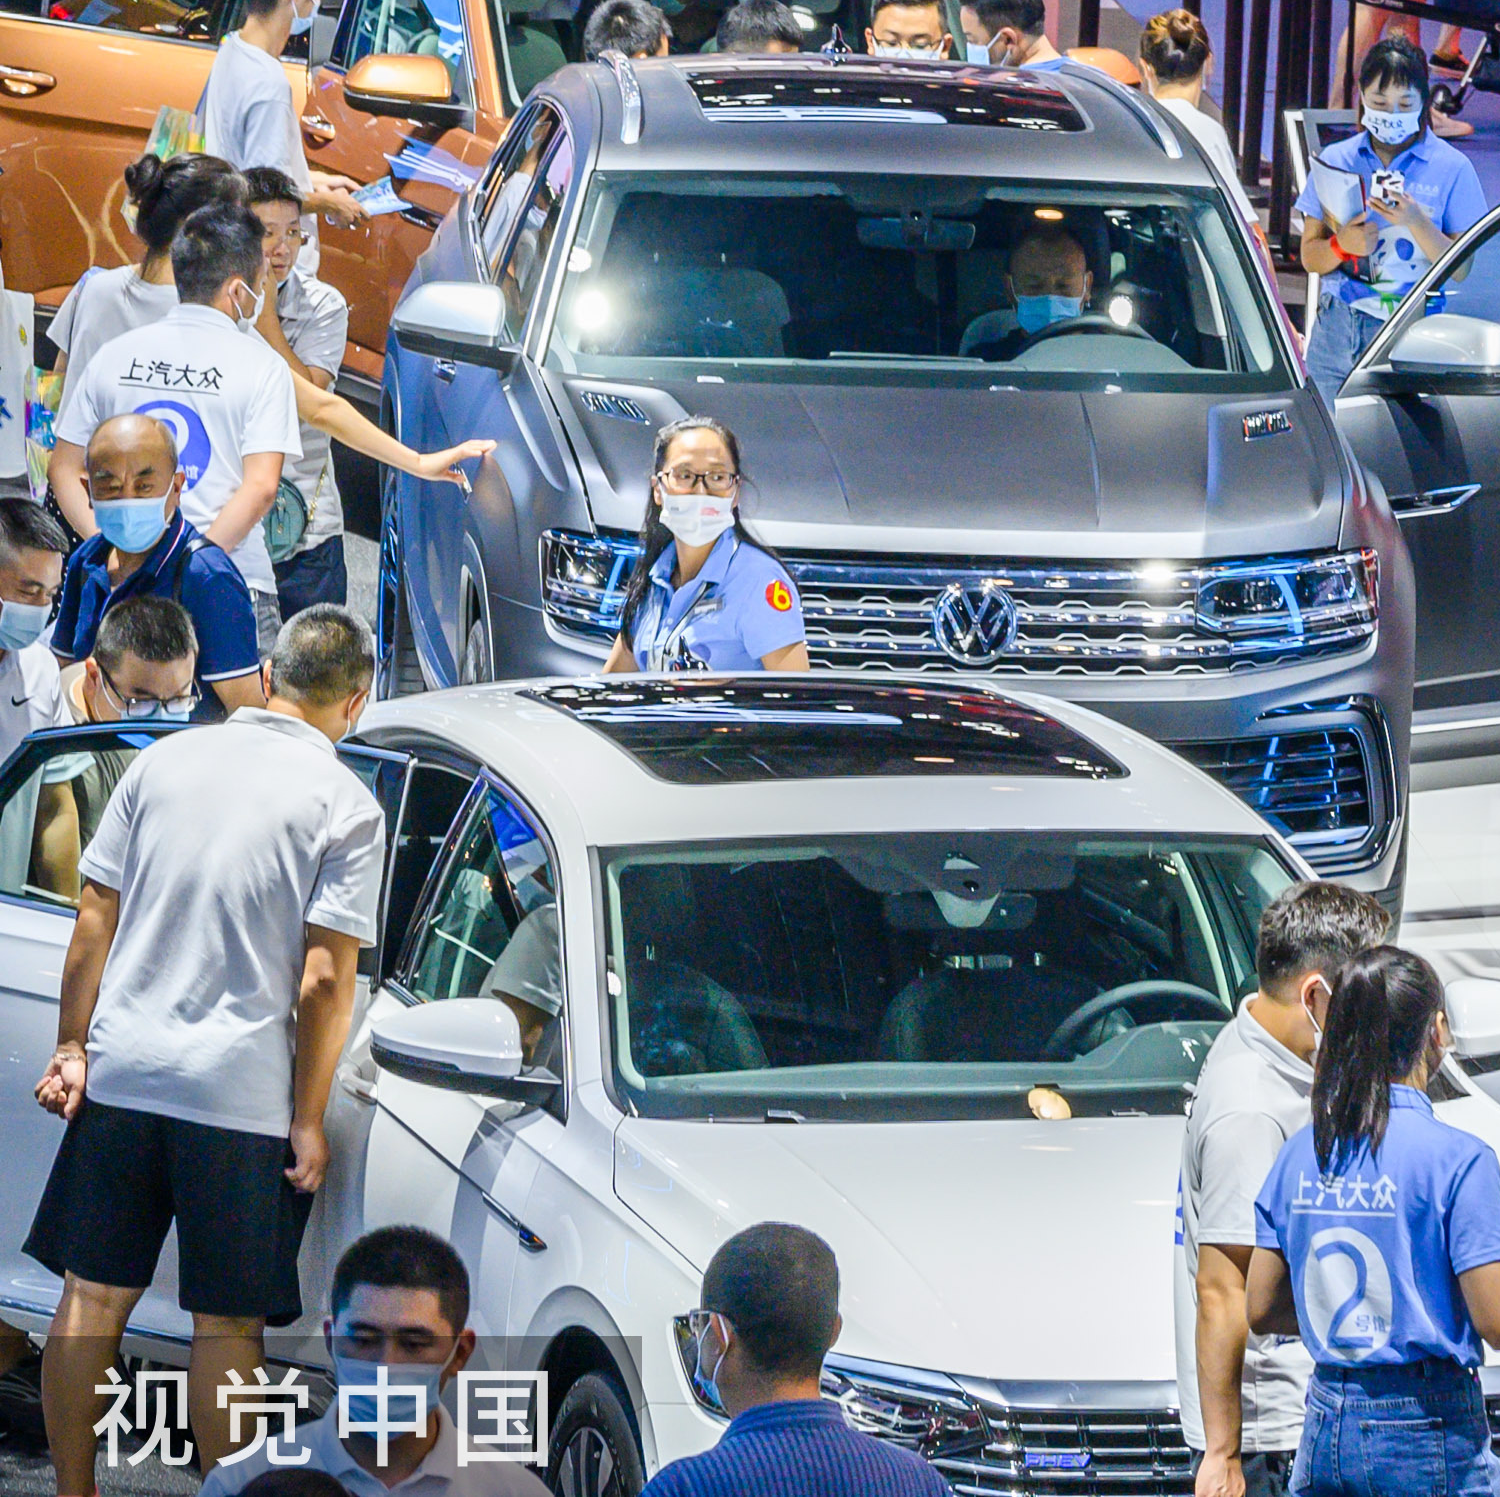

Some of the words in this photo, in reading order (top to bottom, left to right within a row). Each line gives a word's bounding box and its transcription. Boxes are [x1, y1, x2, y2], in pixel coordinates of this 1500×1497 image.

[118, 357, 223, 391] 上汽大众
[1289, 1173, 1395, 1211] 上汽大众
[1311, 1239, 1372, 1350] 2
[1022, 1453, 1090, 1468] PHEV
